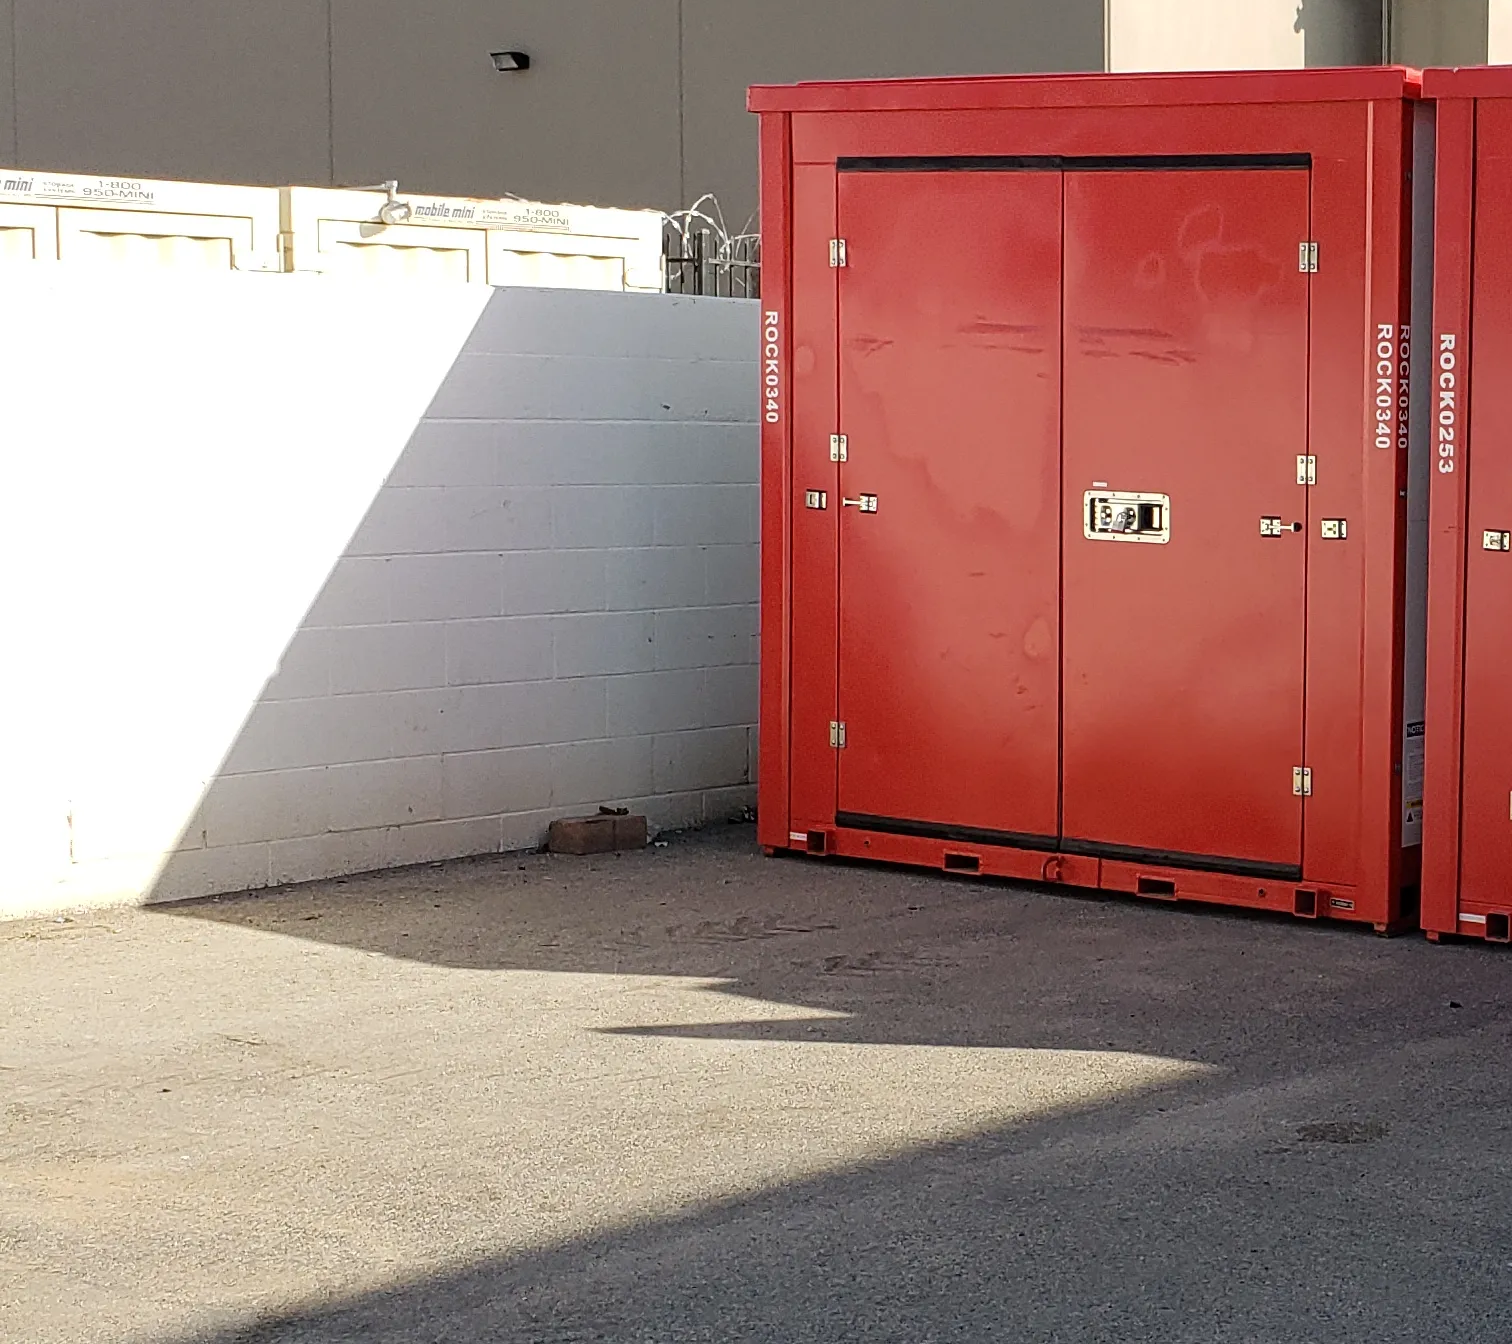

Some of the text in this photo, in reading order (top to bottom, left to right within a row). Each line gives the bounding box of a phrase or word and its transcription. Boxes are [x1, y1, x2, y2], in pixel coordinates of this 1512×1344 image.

[3, 176, 34, 192] mini
[99, 180, 141, 190] 1-800
[82, 187, 154, 199] 950-MINI
[415, 202, 450, 218] mobile
[451, 206, 475, 218] mini
[526, 208, 559, 218] 1-800
[513, 216, 569, 226] 950-MINI
[765, 311, 778, 423] ROCK0340
[1375, 324, 1393, 449] ROCK0340
[1398, 325, 1410, 449] ROCK0340
[1438, 334, 1456, 474] ROCK0253
